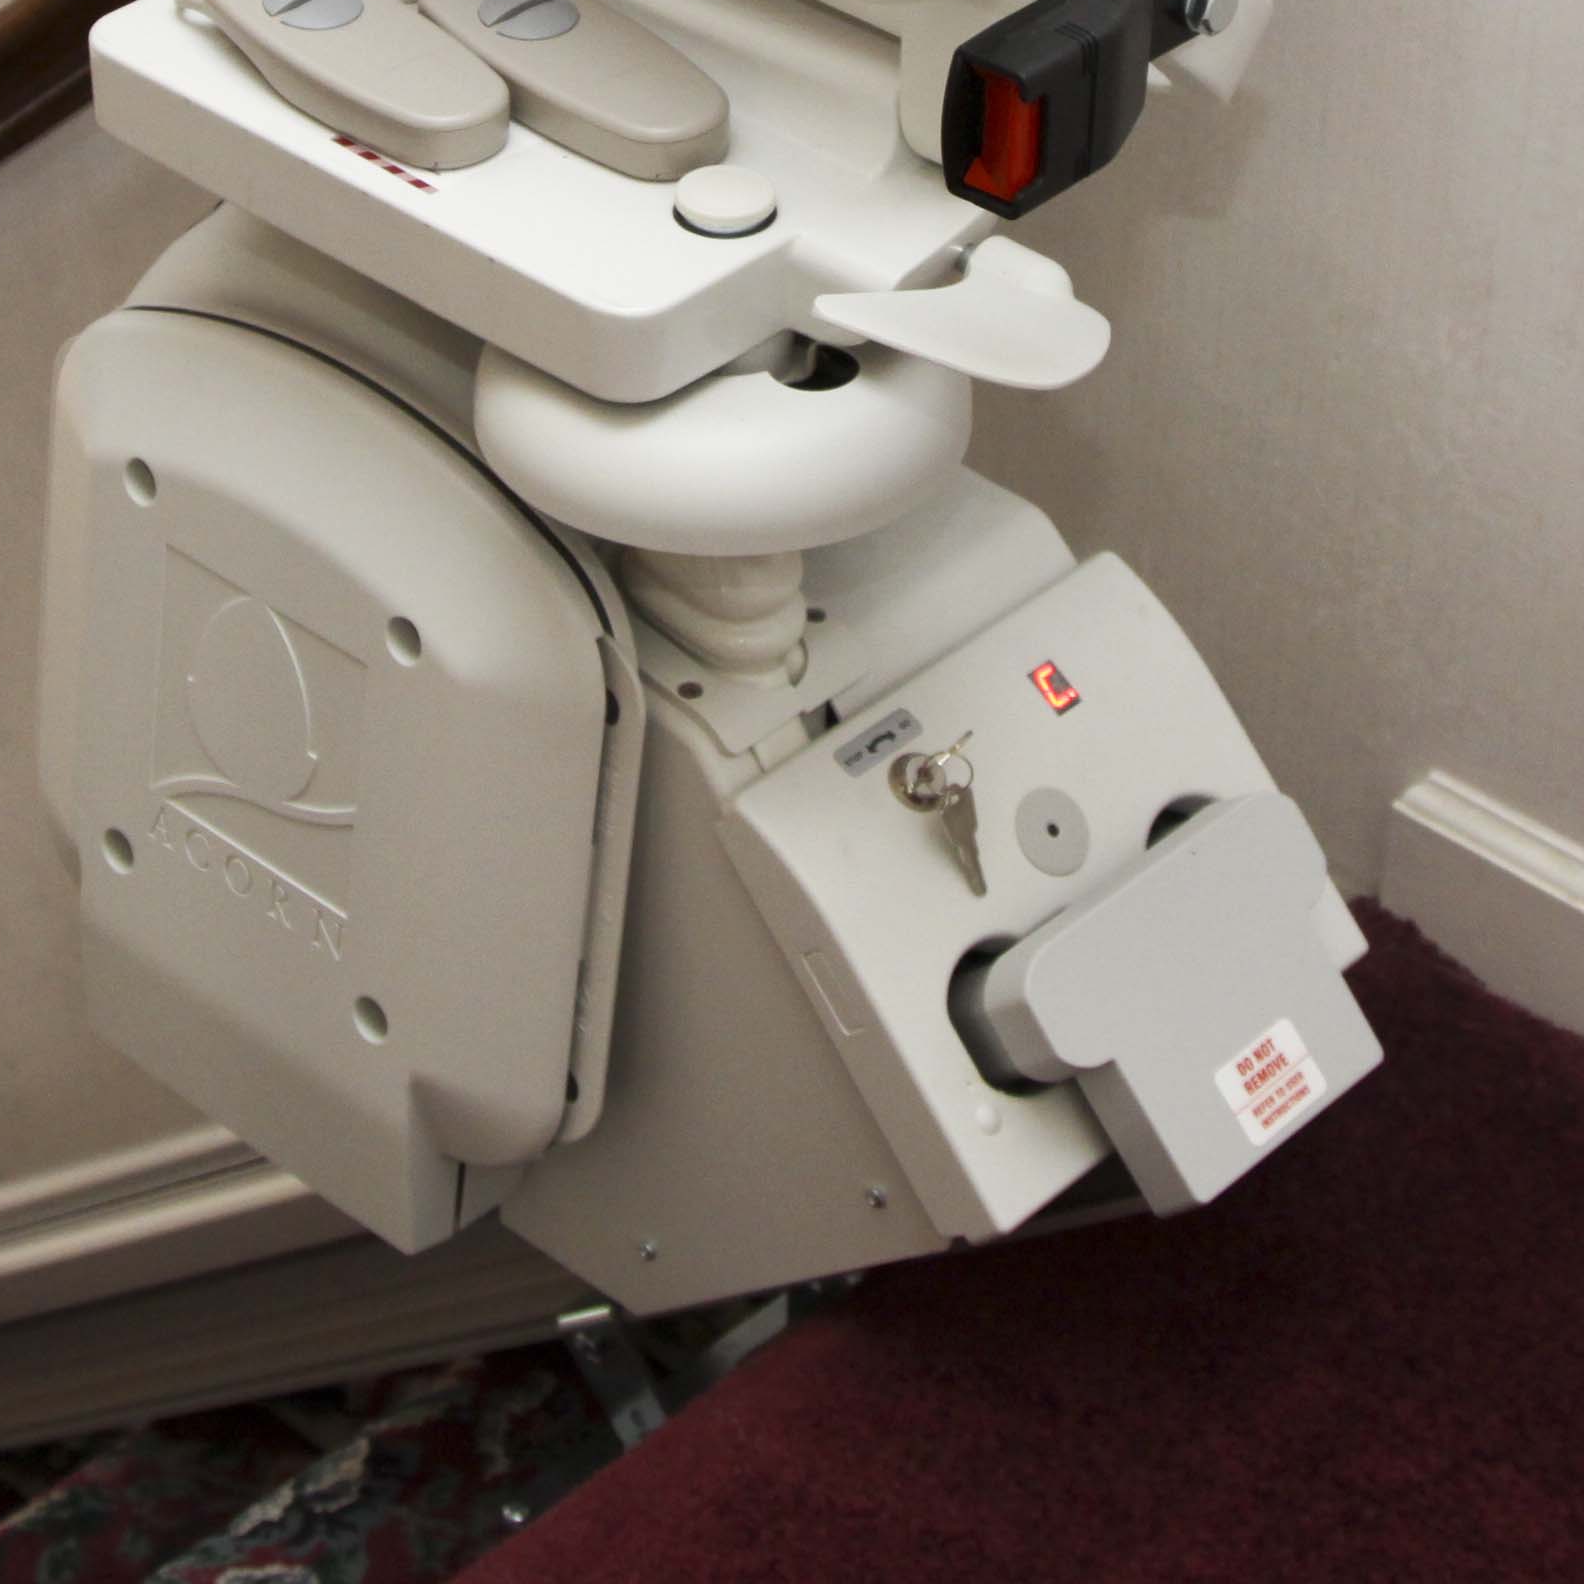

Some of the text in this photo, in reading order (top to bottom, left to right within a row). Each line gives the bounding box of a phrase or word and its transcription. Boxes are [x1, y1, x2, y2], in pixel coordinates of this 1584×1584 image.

[147, 804, 345, 962] ACORN
[1235, 1038, 1276, 1077] DO NOT
[1243, 1053, 1290, 1096] REMOVE
